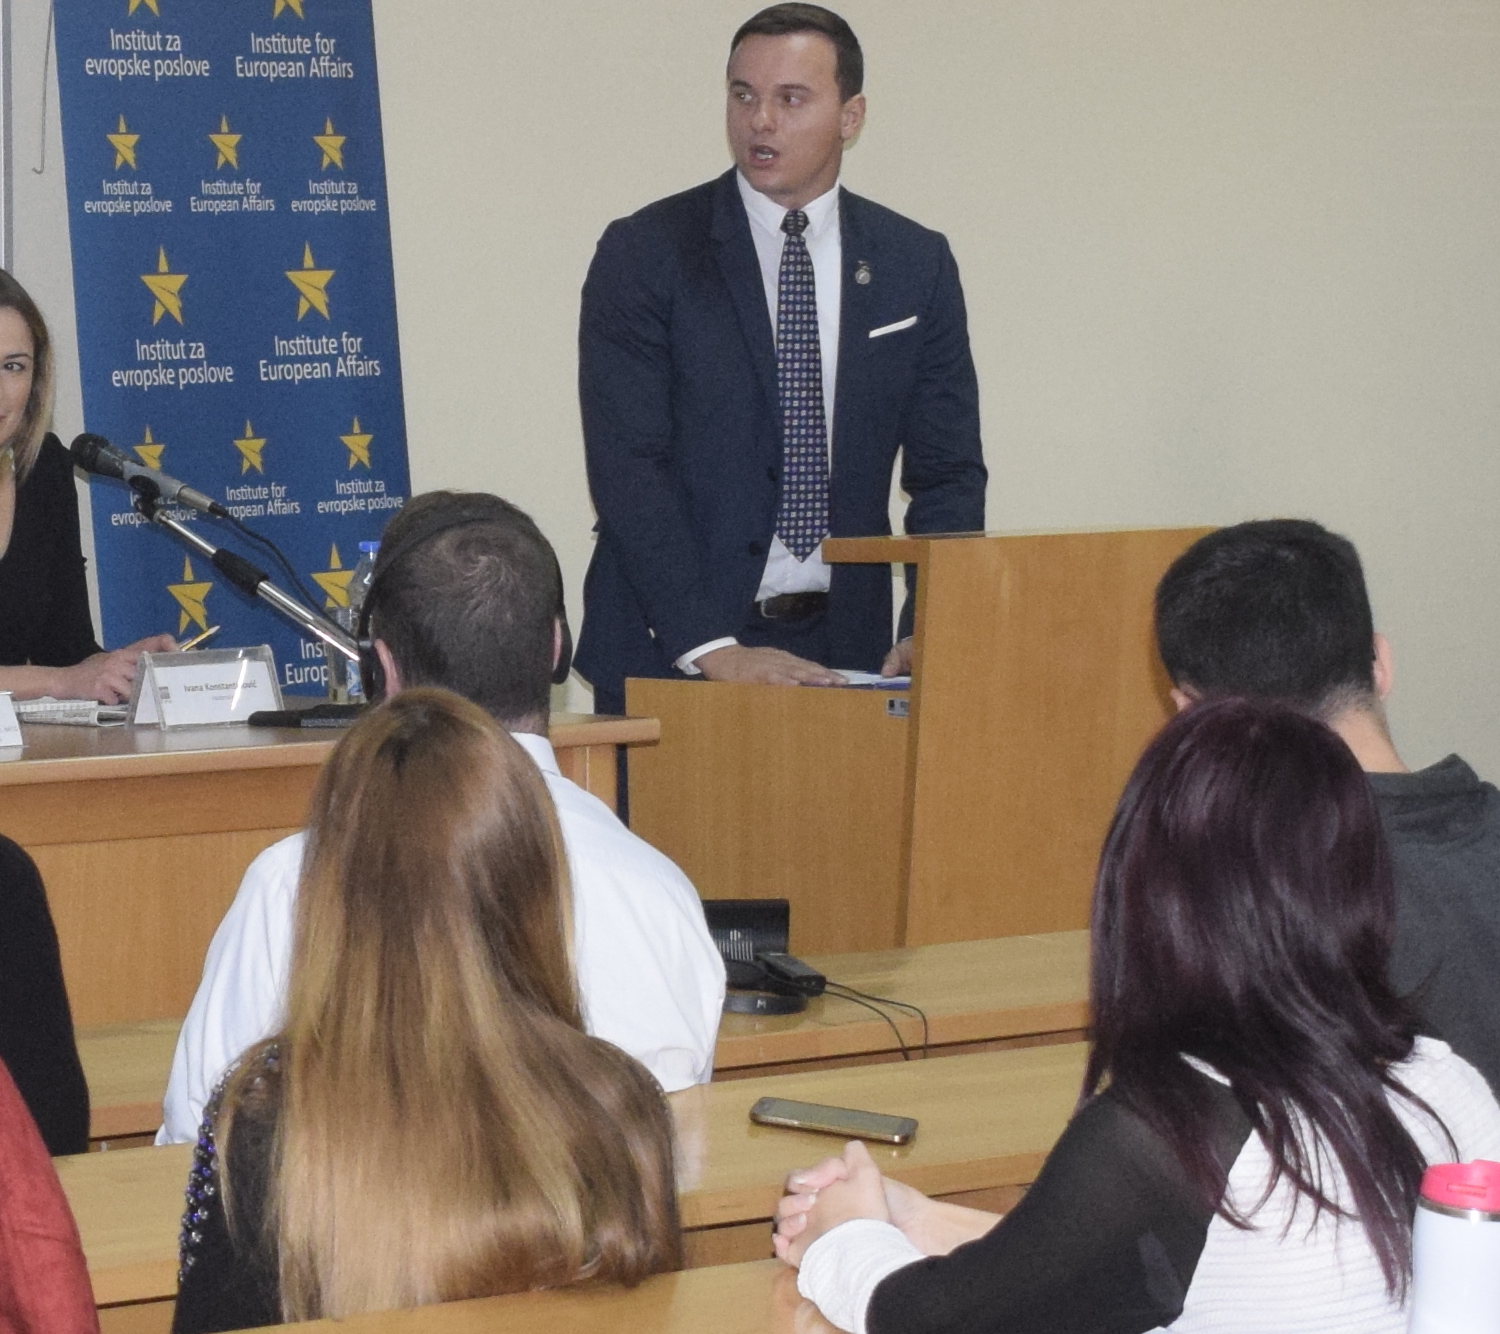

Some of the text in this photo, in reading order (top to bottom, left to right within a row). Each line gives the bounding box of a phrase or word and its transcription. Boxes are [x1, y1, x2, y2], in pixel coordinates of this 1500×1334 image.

[109, 27, 182, 52] Institut za
[250, 31, 336, 55] Institute for
[84, 52, 210, 82] evropske poslove
[235, 55, 354, 83] European Affairs
[102, 179, 152, 196] Institut za
[201, 177, 262, 195] Institute for
[308, 179, 358, 195] Institut za
[84, 195, 173, 217] evropske poslove
[189, 194, 275, 216] European Affairs
[290, 195, 377, 216] evropske poslove
[135, 338, 206, 361] Institut za
[274, 331, 363, 358] Institute for
[111, 360, 234, 392] evropske poslove
[259, 354, 381, 385] European Affairs
[226, 482, 287, 502] Institute for
[335, 479, 385, 495] Institut za
[165, 505, 198, 522] oslove
[228, 498, 301, 521] ropean Affairs
[317, 493, 404, 516] evropske poslove
[205, 680, 257, 692] Konstantiović
[285, 662, 331, 687] Europ
